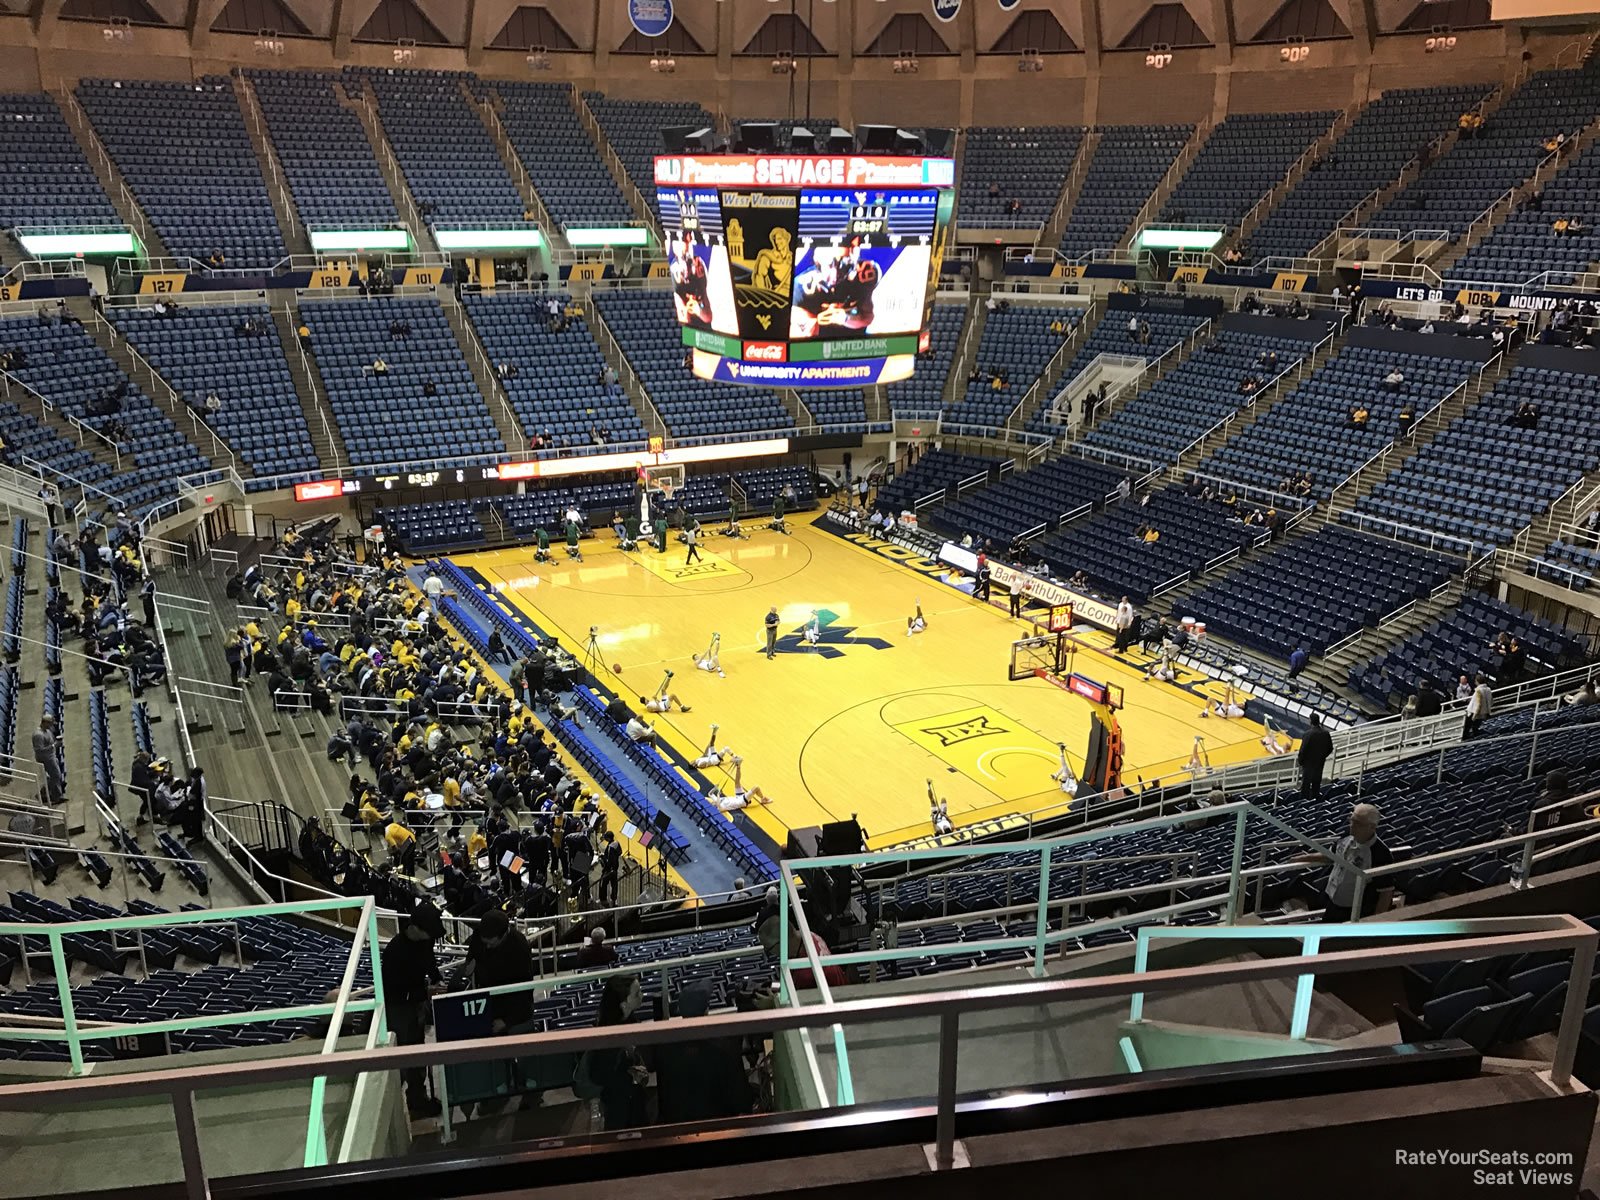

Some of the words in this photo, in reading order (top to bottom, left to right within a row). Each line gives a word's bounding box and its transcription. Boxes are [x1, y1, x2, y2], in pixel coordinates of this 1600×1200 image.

[1146, 54, 1173, 69] 207
[756, 158, 845, 183] SEWAGE
[416, 274, 432, 285] 101
[581, 270, 594, 280] 101
[1061, 267, 1077, 278] 105
[1182, 272, 1198, 284] 106
[152, 281, 173, 293] 127
[320, 276, 341, 287] 128
[1281, 278, 1297, 292] 107
[1396, 287, 1424, 301] LET'S
[1428, 289, 1443, 302] GO
[1467, 292, 1489, 305] 108
[832, 340, 863, 351] UNITED
[865, 338, 887, 350] BANK
[740, 365, 801, 379] UNIVERSITY
[801, 366, 870, 379] APARTMENTS
[639, 521, 652, 535] G
[1547, 811, 1560, 826] 116
[463, 998, 487, 1017] 117
[115, 1036, 139, 1051] 118
